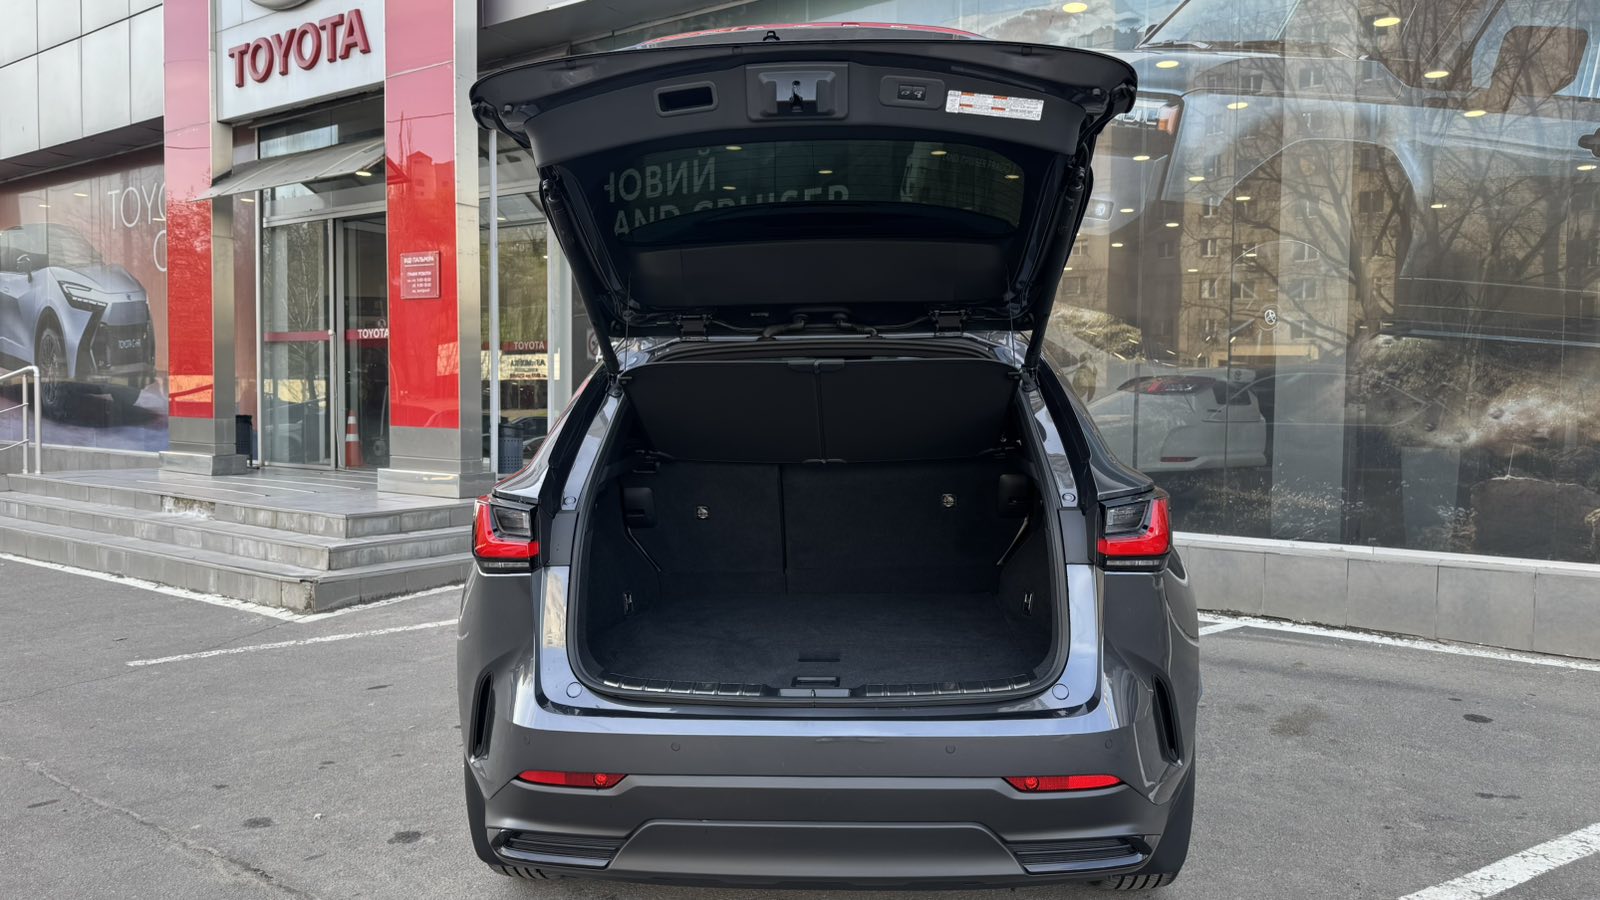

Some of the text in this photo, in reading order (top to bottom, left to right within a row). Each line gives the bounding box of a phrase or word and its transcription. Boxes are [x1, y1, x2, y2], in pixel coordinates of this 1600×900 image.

[228, 8, 371, 88] TOYOTA
[357, 328, 389, 339] TOYOTA
[514, 341, 545, 350] TOYOTA
